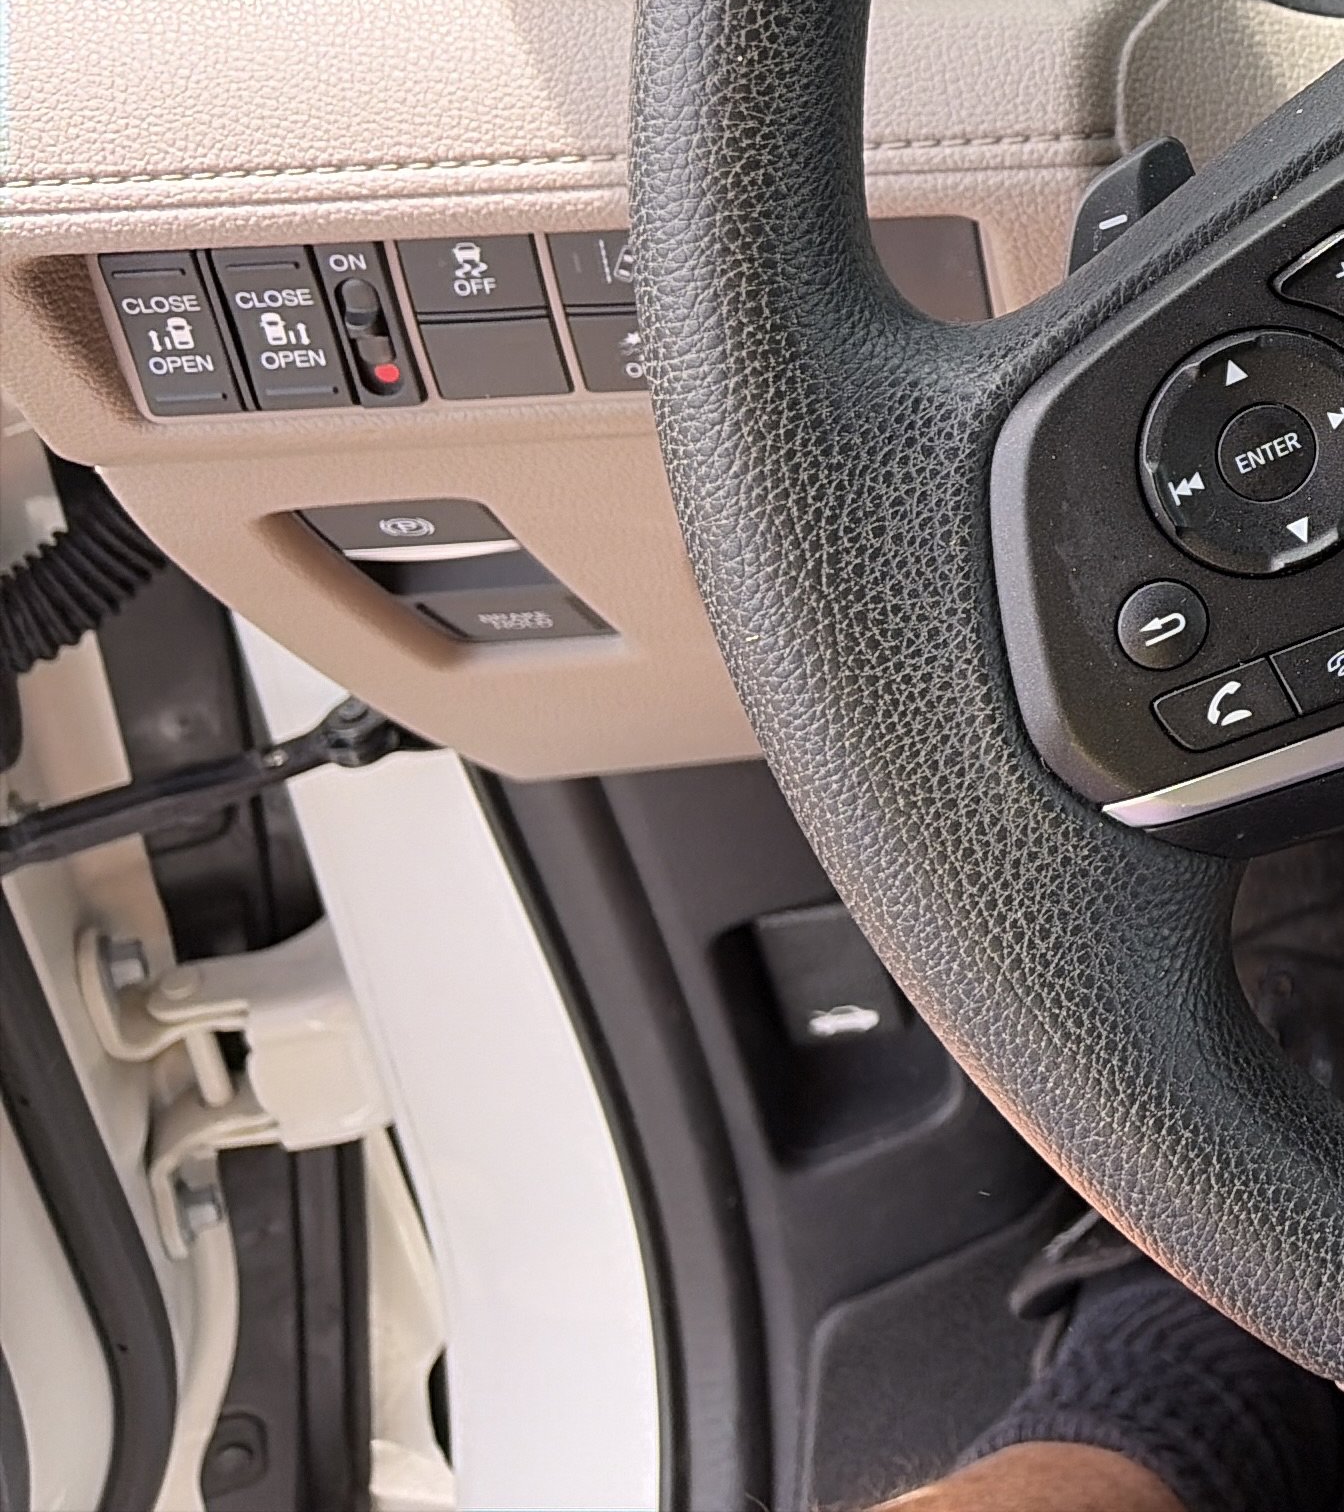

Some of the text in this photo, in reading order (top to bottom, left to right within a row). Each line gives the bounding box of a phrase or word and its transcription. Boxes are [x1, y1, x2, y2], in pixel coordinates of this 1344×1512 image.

[329, 253, 367, 272] ON
[454, 277, 496, 296] OFF
[121, 294, 201, 314] CLOSE
[235, 288, 314, 309] CLOSE
[148, 354, 214, 375] OPEN
[260, 348, 327, 370] OPEN
[1234, 431, 1302, 475] ENTER
